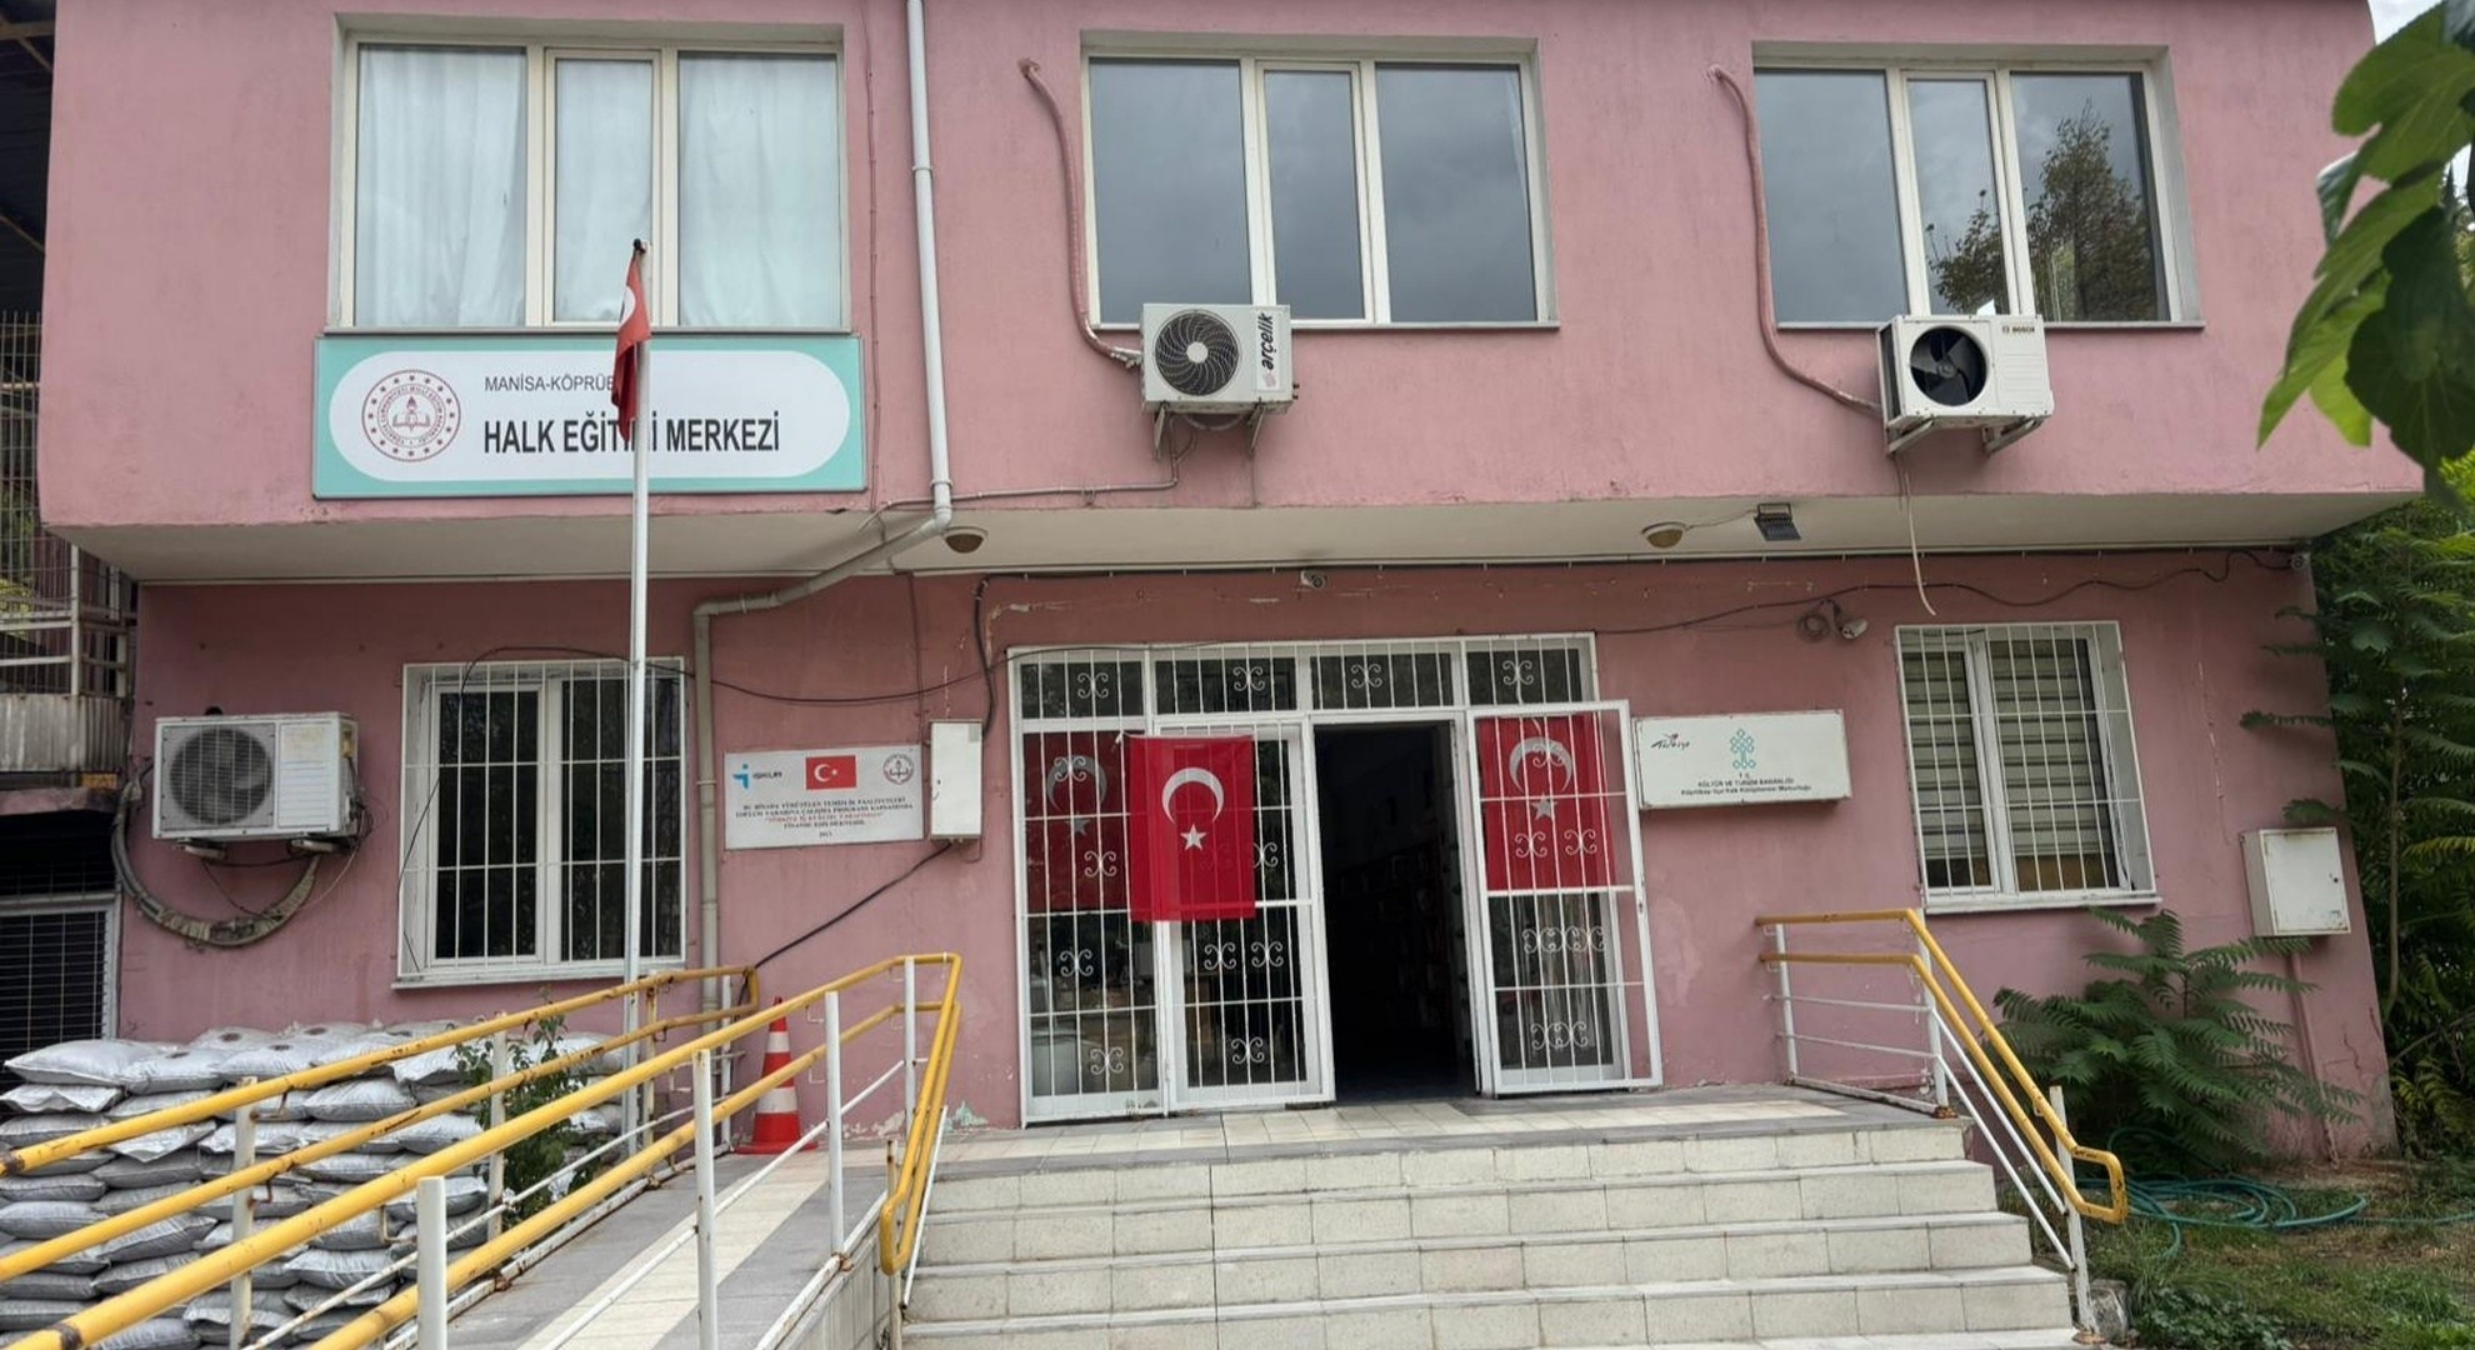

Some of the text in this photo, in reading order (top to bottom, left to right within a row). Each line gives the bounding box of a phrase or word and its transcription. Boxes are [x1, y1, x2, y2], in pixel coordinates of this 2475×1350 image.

[1258, 312, 1277, 371] arçelik
[485, 373, 615, 391] MANİSA-KÖPRÜB
[485, 410, 780, 453] HALK EĞİTİ MERKEZİ
